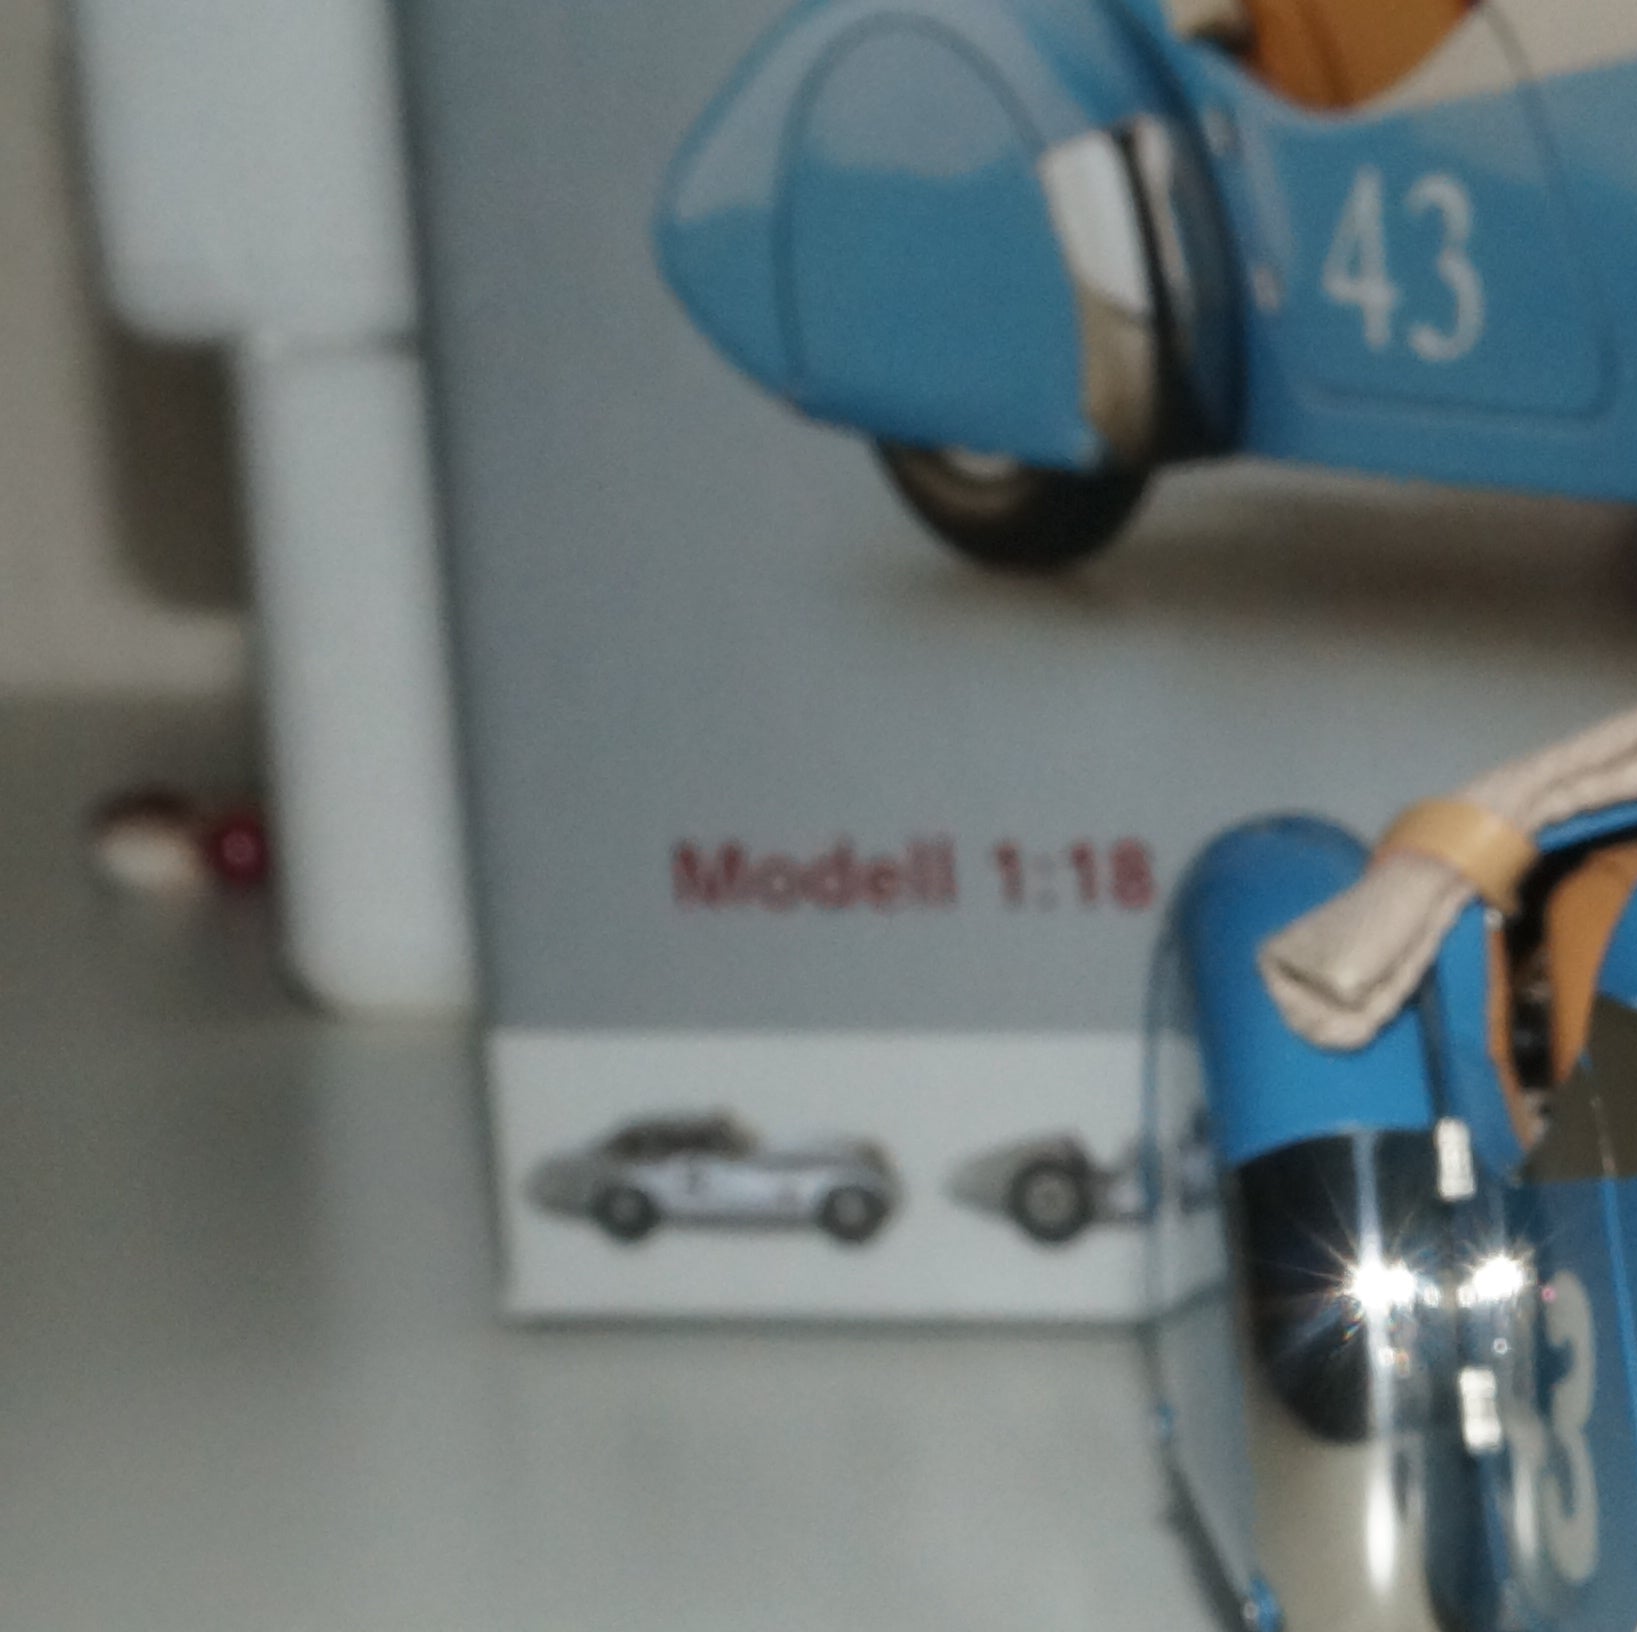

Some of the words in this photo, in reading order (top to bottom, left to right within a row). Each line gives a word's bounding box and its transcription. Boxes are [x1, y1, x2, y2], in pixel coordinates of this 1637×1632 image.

[1320, 164, 1486, 362] 43
[673, 835, 957, 909] Modell
[994, 836, 1155, 910] 1:18
